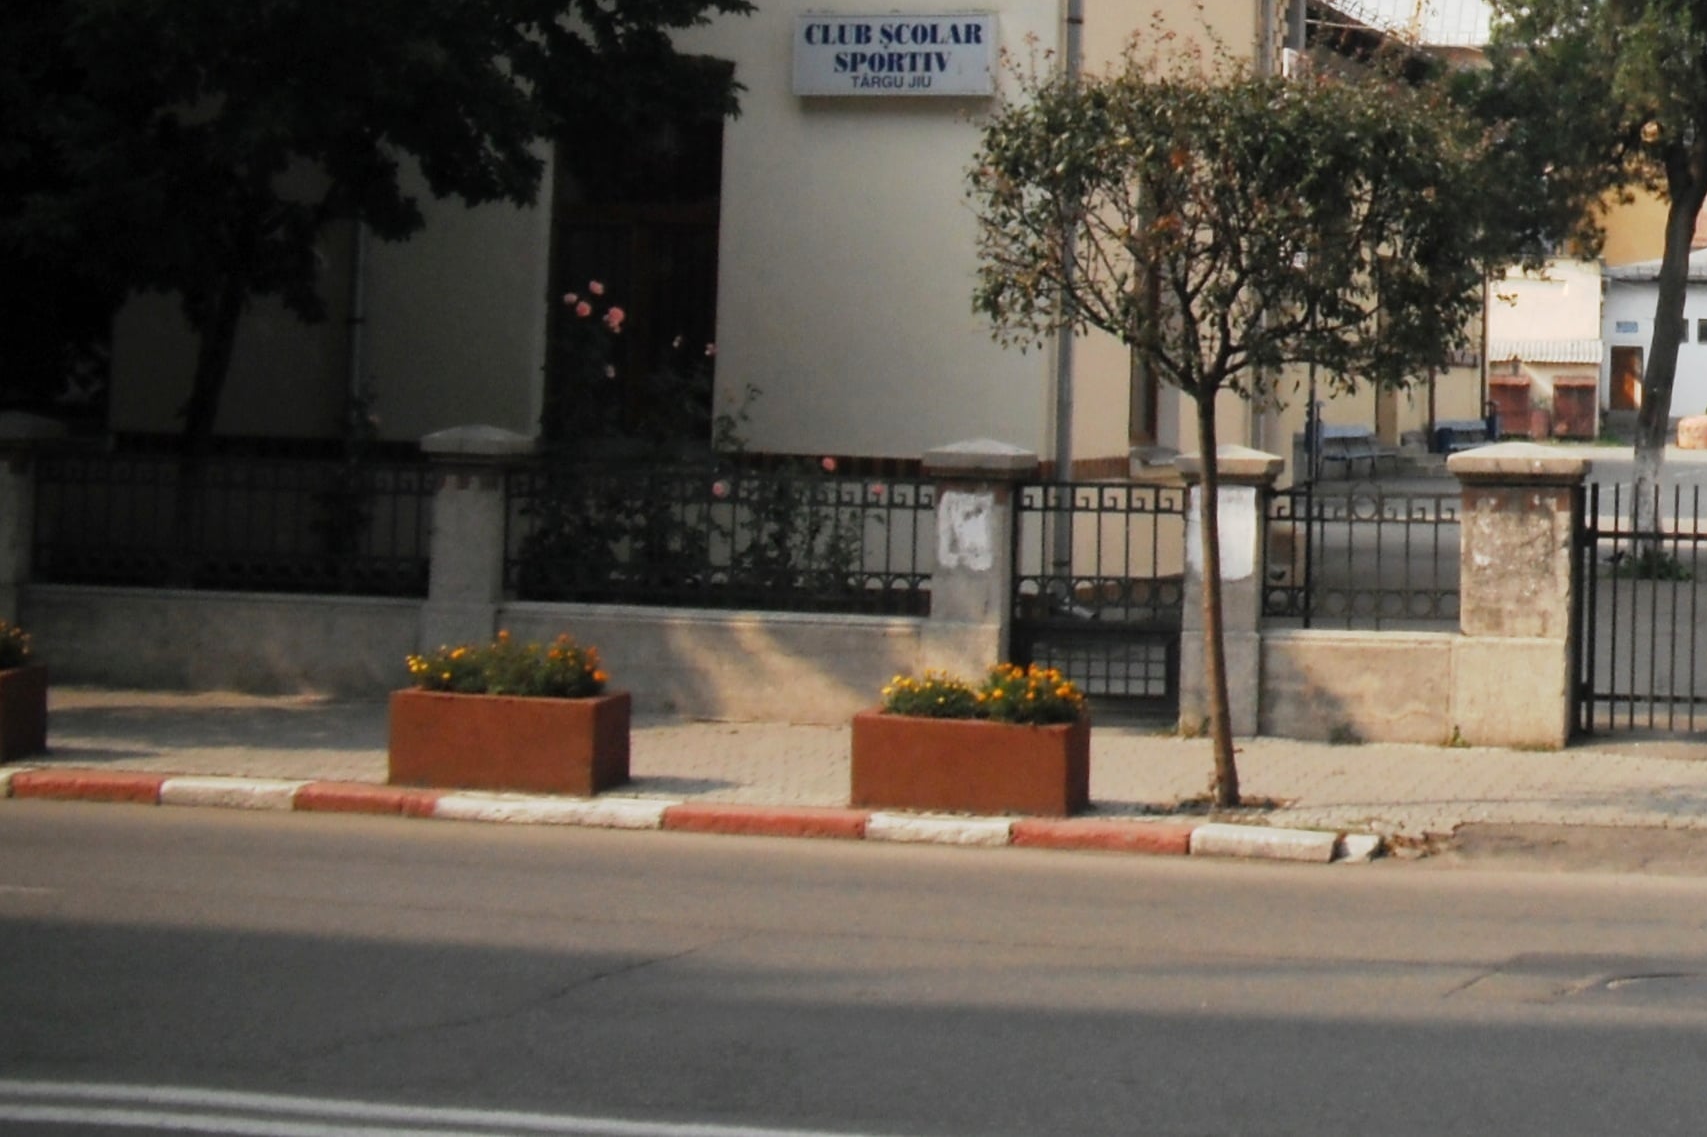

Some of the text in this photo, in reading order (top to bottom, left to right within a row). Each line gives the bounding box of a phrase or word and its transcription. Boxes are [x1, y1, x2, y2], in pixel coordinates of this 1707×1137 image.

[804, 23, 872, 45] CLUB
[833, 51, 951, 74] SPORTIV
[850, 72, 933, 89] TÂRGU JIU
